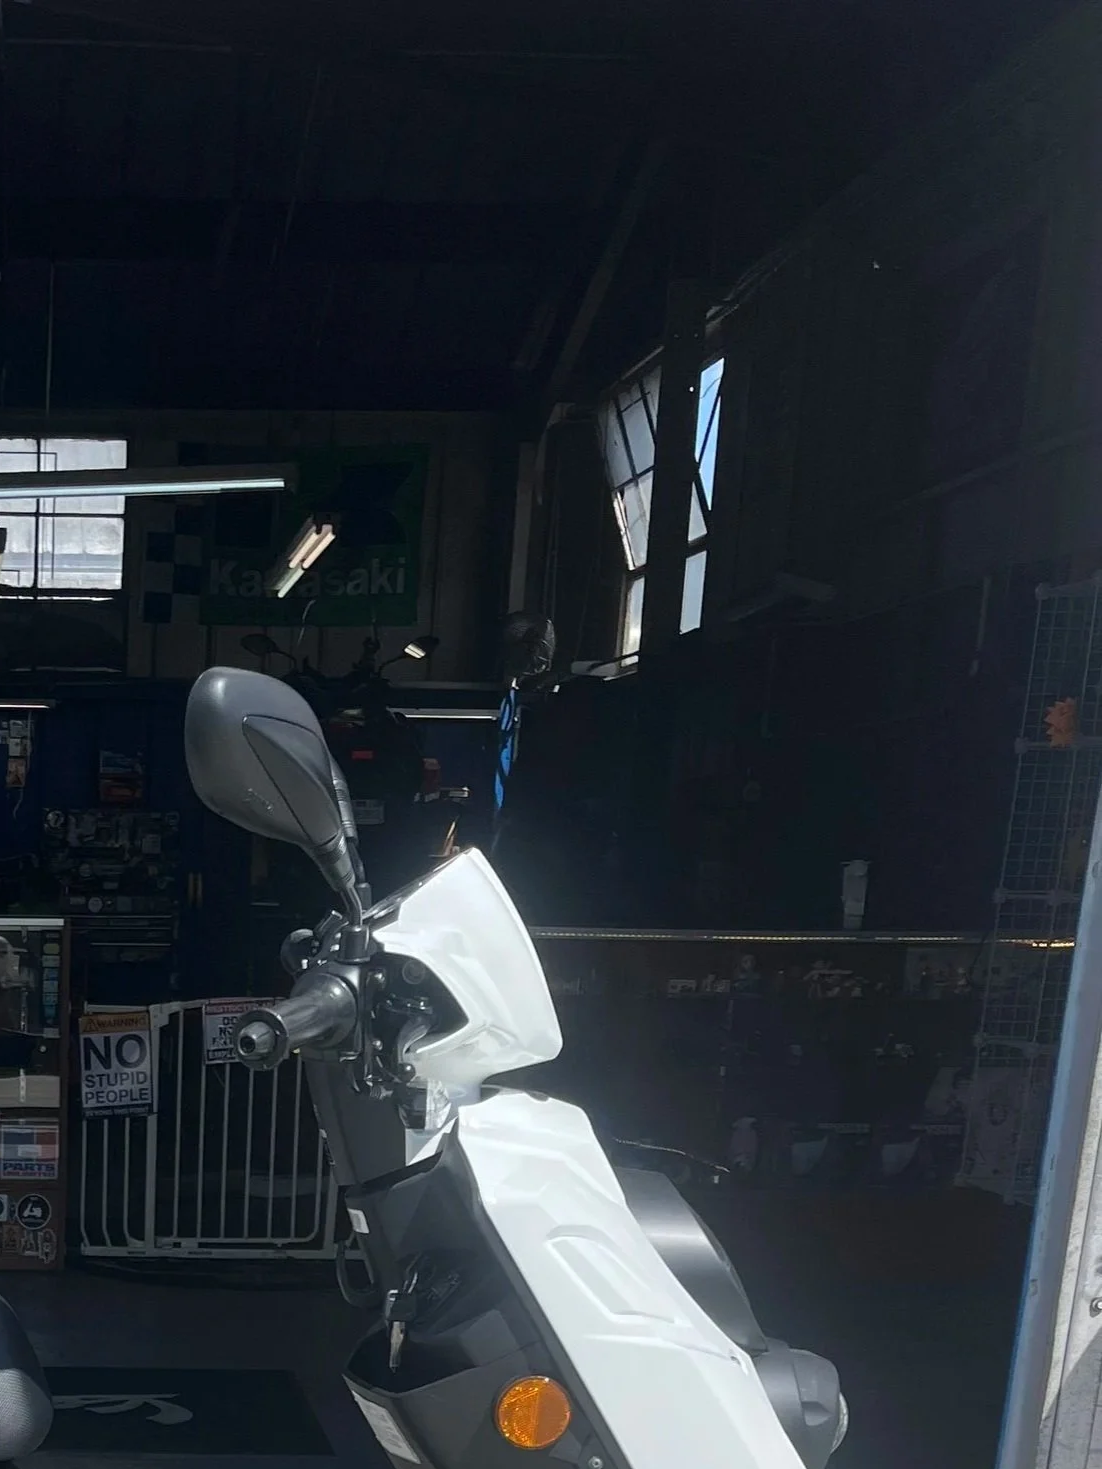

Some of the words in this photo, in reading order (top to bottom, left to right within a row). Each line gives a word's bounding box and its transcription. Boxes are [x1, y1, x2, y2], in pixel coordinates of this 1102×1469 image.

[209, 557, 407, 598] Kaasaki
[96, 1016, 147, 1029] WARNING
[83, 1033, 147, 1071] NO
[85, 1071, 147, 1089] STUPID
[85, 1087, 149, 1105] PEOPLE
[2, 1162, 55, 1171] PARTS
